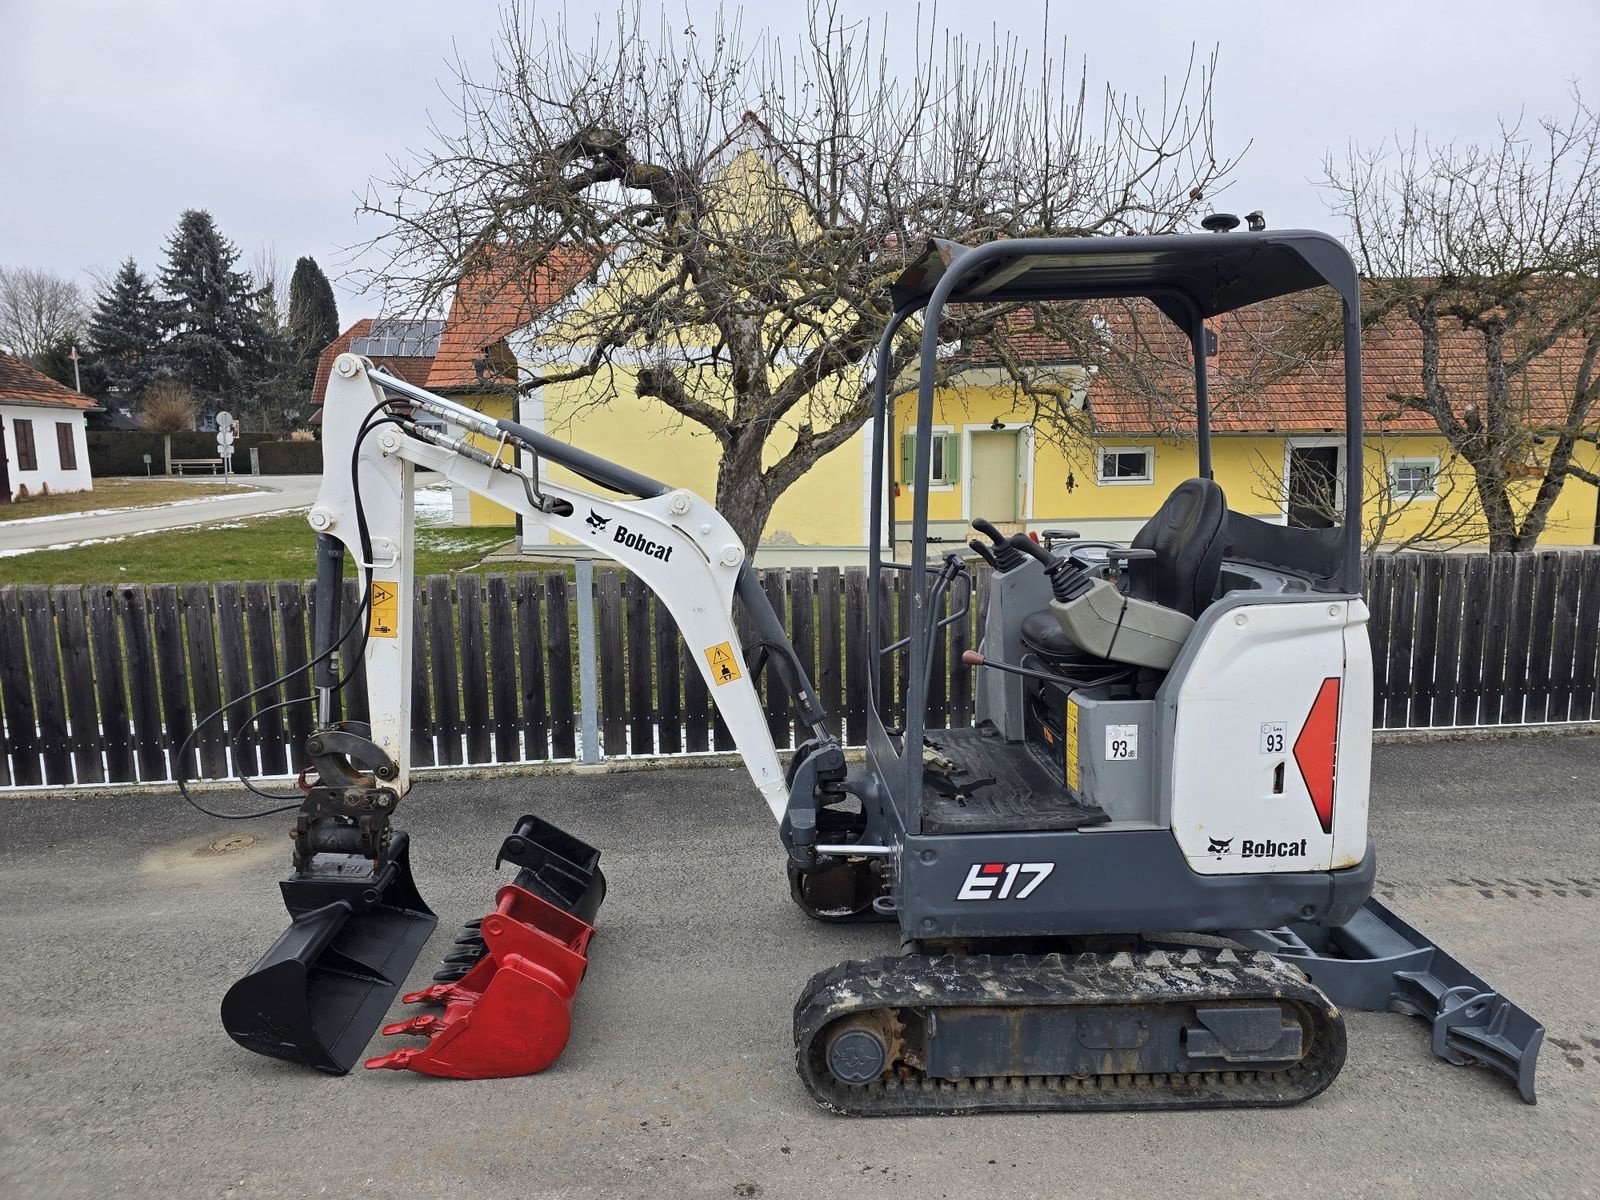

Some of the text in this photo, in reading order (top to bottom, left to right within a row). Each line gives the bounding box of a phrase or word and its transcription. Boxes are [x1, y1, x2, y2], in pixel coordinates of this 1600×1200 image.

[613, 525, 673, 562] Bobcat
[1112, 740, 1127, 758] 93
[1267, 734, 1283, 752] 93
[1241, 839, 1307, 858] Bobcat
[957, 863, 1055, 900] E17
